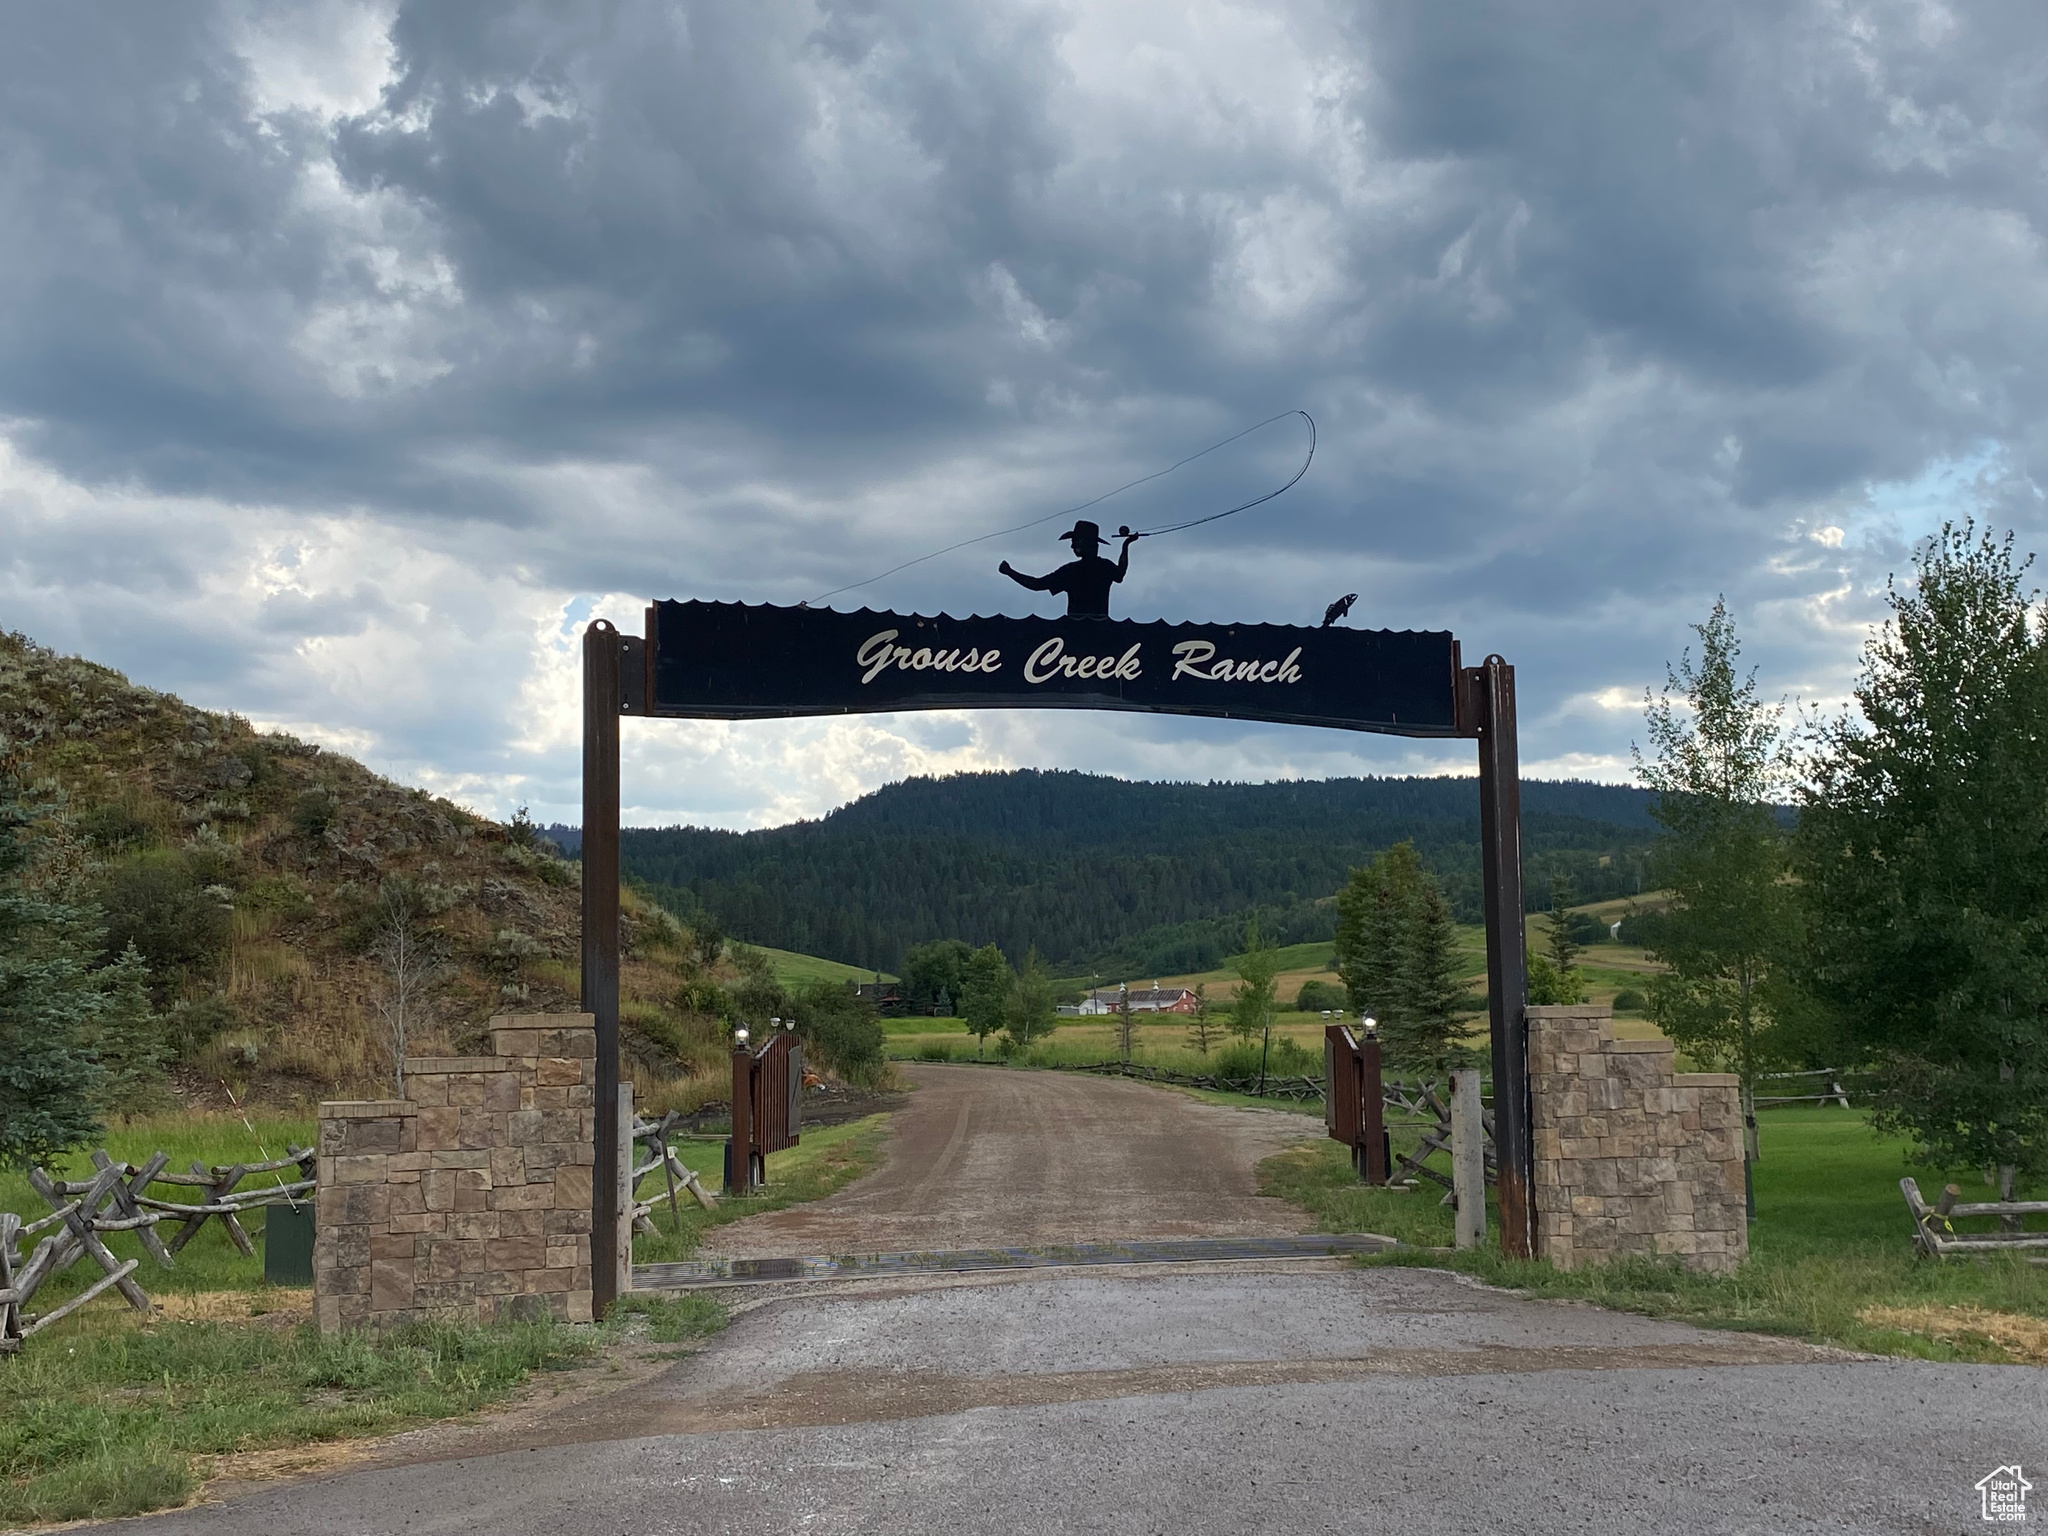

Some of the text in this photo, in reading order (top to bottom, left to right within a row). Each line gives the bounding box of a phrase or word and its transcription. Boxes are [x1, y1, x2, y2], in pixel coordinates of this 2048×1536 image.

[856, 629, 1303, 685] Grouse Creek Ranch
